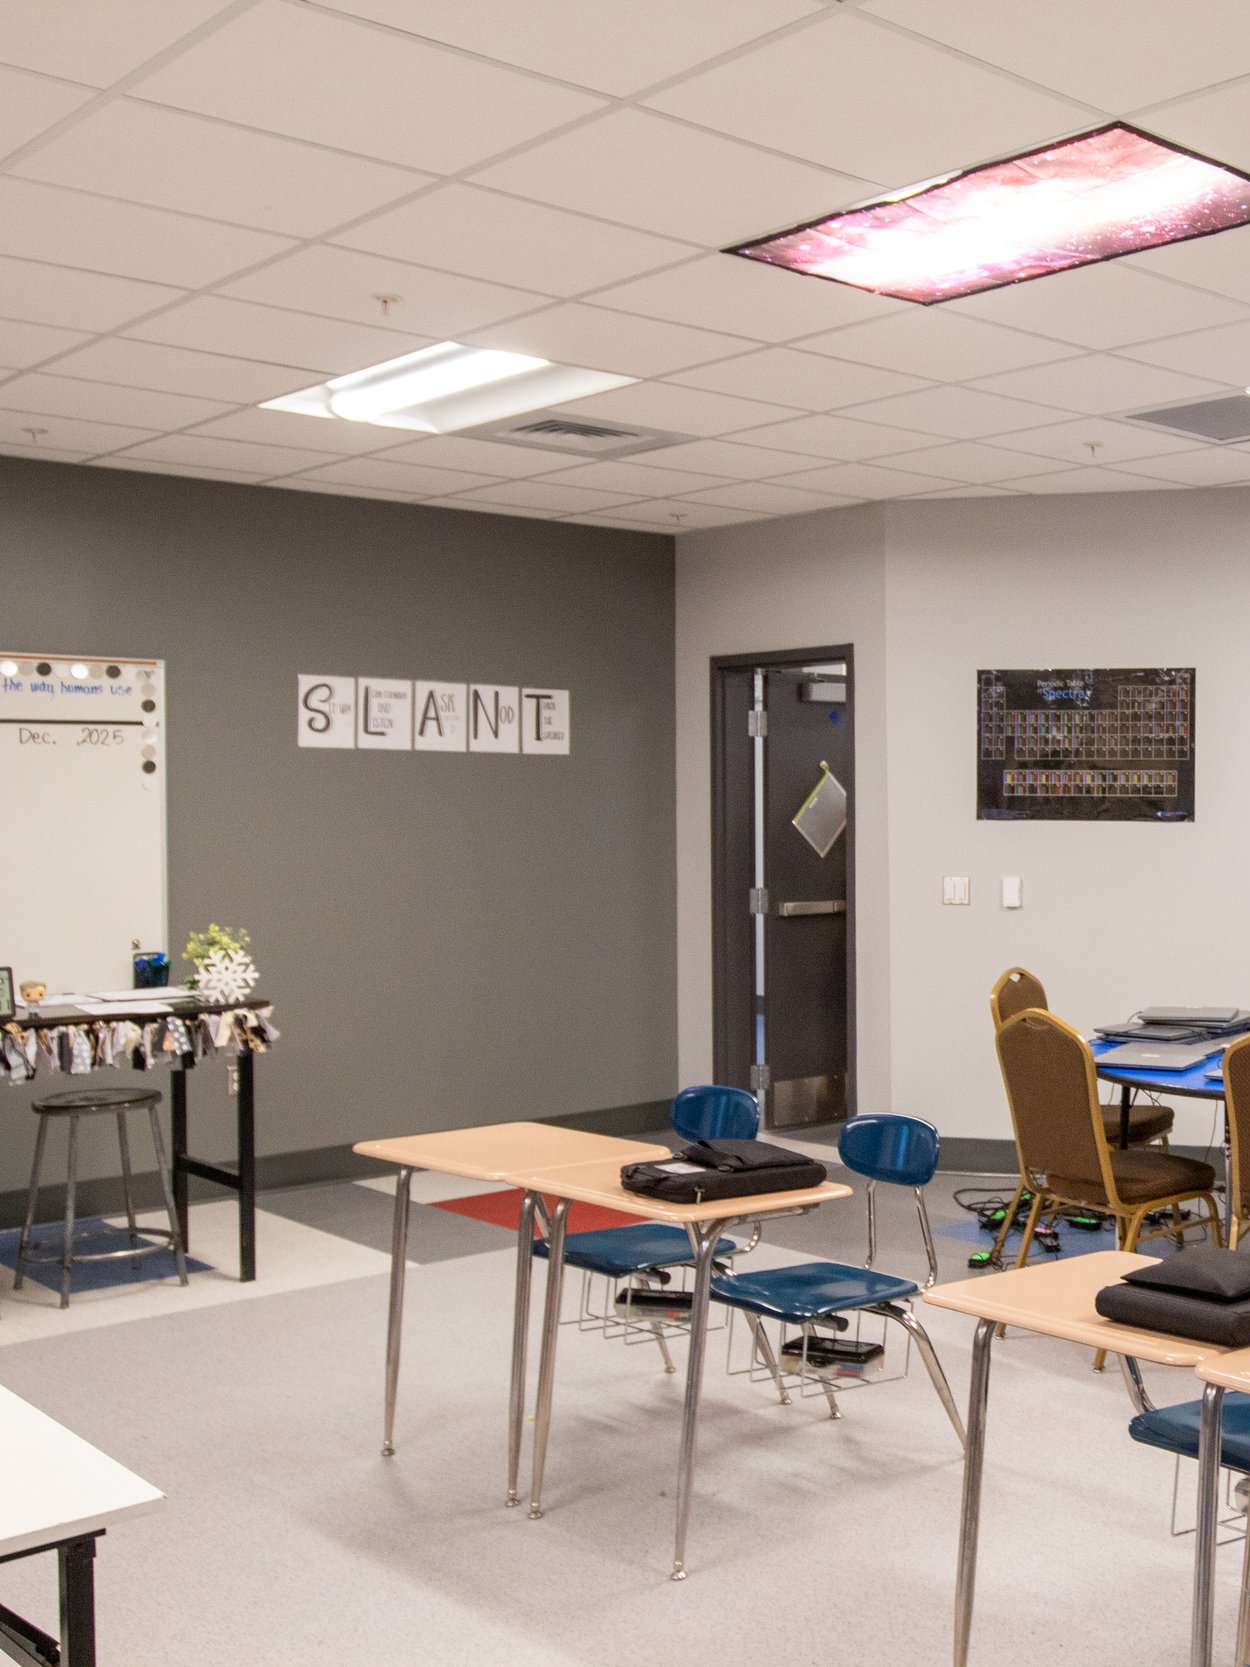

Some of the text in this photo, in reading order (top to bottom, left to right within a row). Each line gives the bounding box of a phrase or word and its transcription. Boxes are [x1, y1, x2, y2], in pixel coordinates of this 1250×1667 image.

[2, 678, 133, 699] the way humans use
[1042, 687, 1085, 701] Spectra
[19, 727, 57, 745] Dec.
